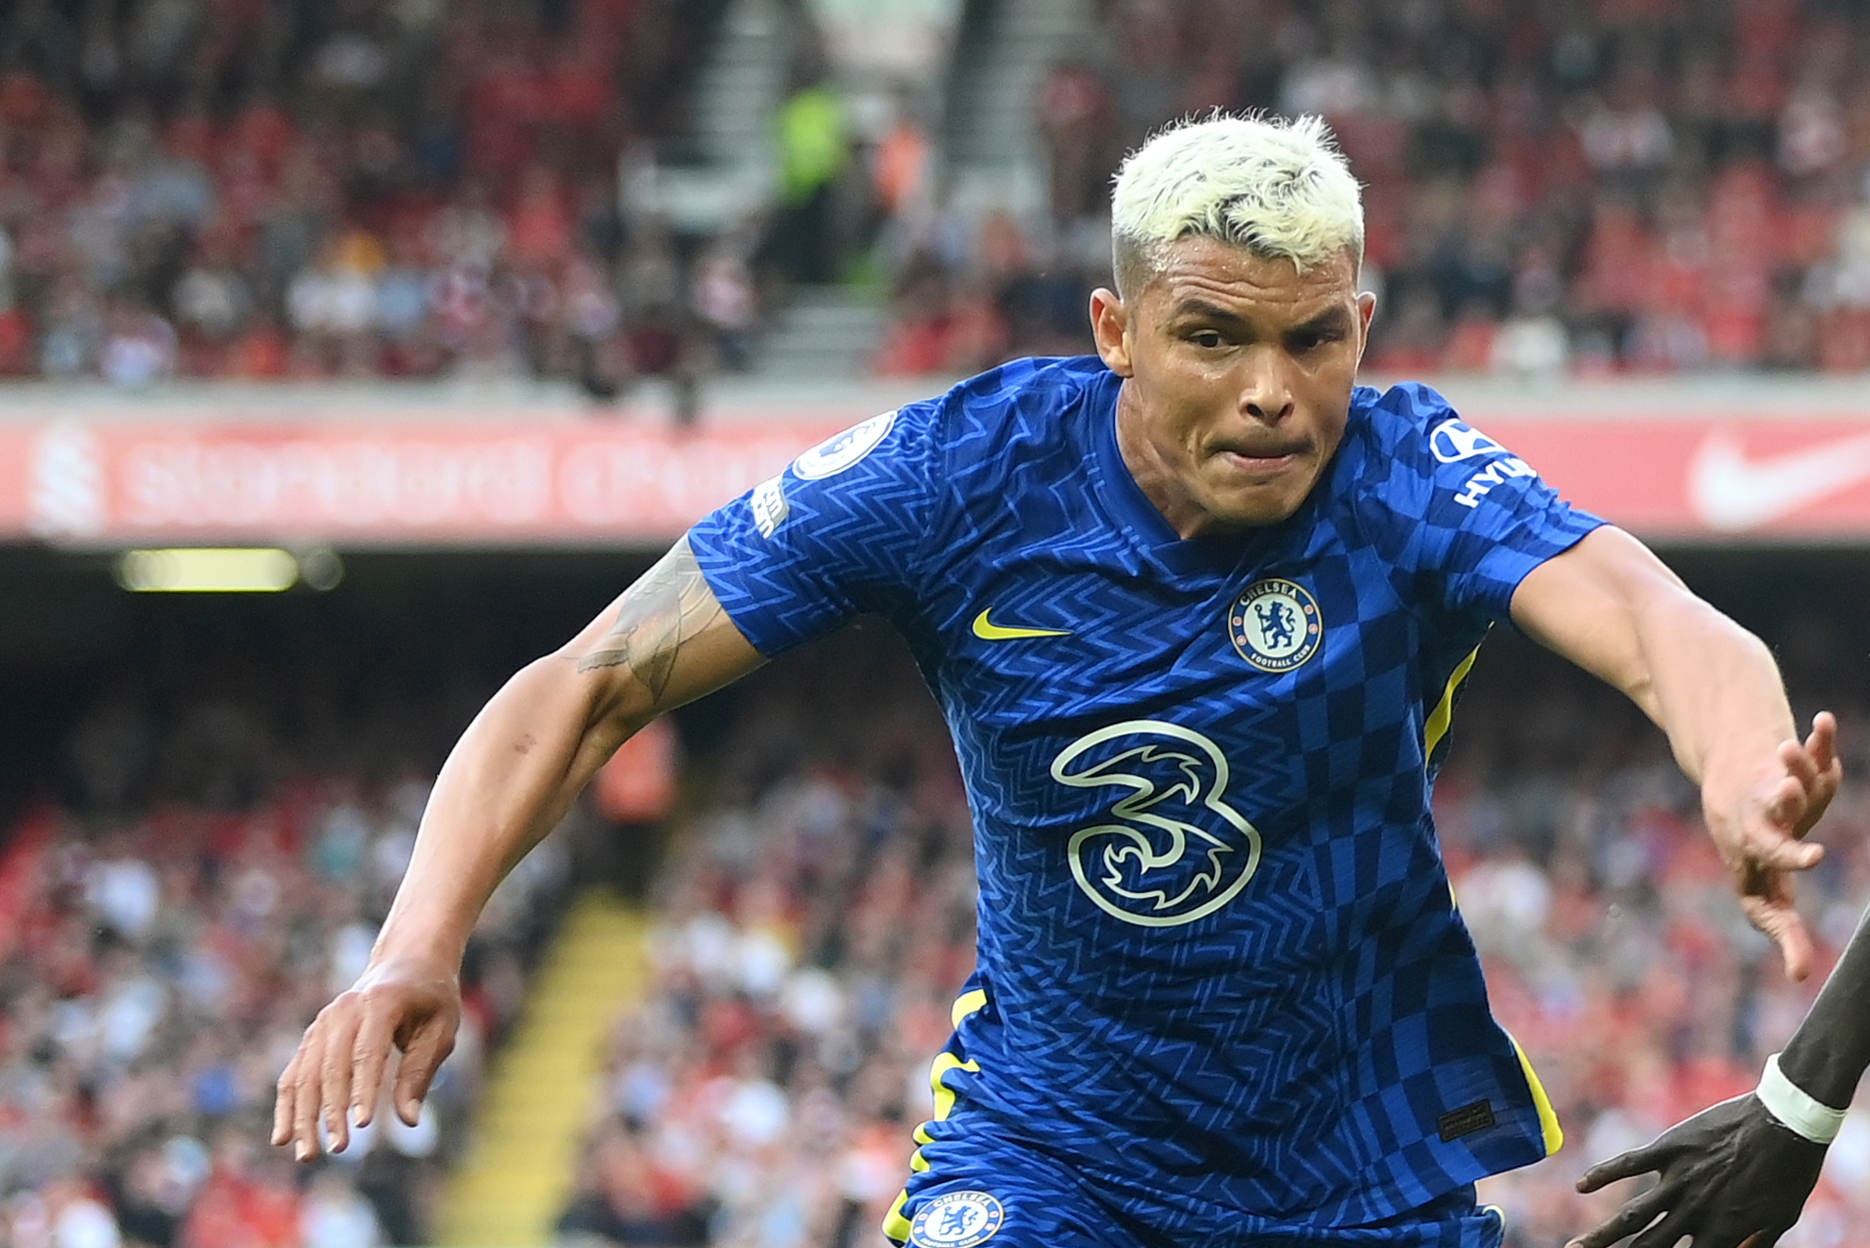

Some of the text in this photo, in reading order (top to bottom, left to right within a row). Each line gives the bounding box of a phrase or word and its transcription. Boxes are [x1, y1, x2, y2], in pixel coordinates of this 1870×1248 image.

[1240, 582, 1298, 606] CHELSEA
[1251, 644, 1311, 667] FOOTBALL CLUB
[1050, 719, 1261, 926] 3
[933, 1191, 992, 1207] CHELSEA
